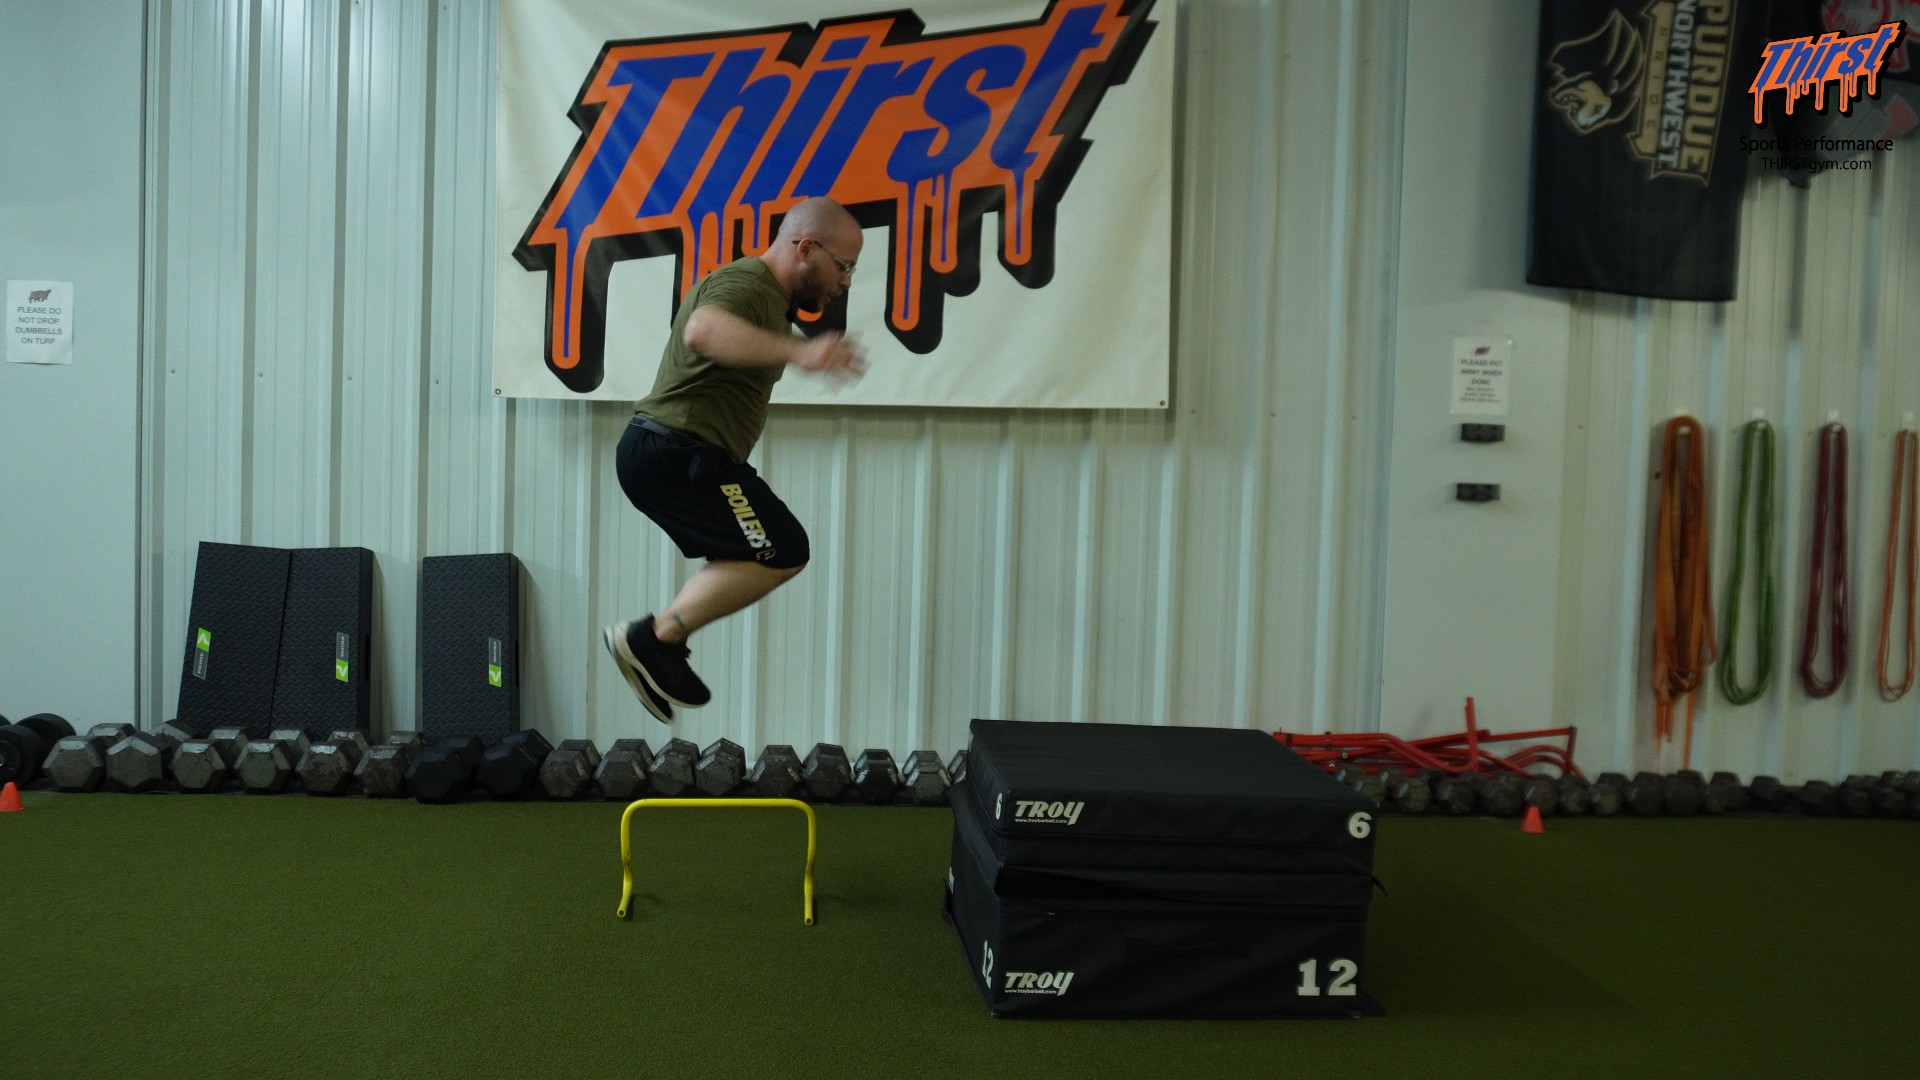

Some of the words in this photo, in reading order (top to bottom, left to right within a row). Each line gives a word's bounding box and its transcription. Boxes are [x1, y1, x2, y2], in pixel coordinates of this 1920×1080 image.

[1646, 26, 1668, 129] PRIDE
[1658, 0, 1697, 169] NORTHWEST
[1680, 0, 1731, 173] PURDUE
[526, 0, 1136, 370] Thirst
[17, 306, 48, 314] PLEASE
[48, 307, 62, 315] DO
[18, 316, 36, 324] NOT
[36, 317, 60, 325] DROP
[15, 326, 63, 335] DUMBBELLS
[35, 337, 56, 345] TURF
[720, 483, 772, 548] BOILERS
[995, 792, 1003, 820] 6
[1014, 800, 1085, 826] TROY
[1348, 811, 1373, 839] 6
[982, 939, 994, 990] 12
[1296, 959, 1358, 996] 12
[1004, 972, 1075, 997] TROY
